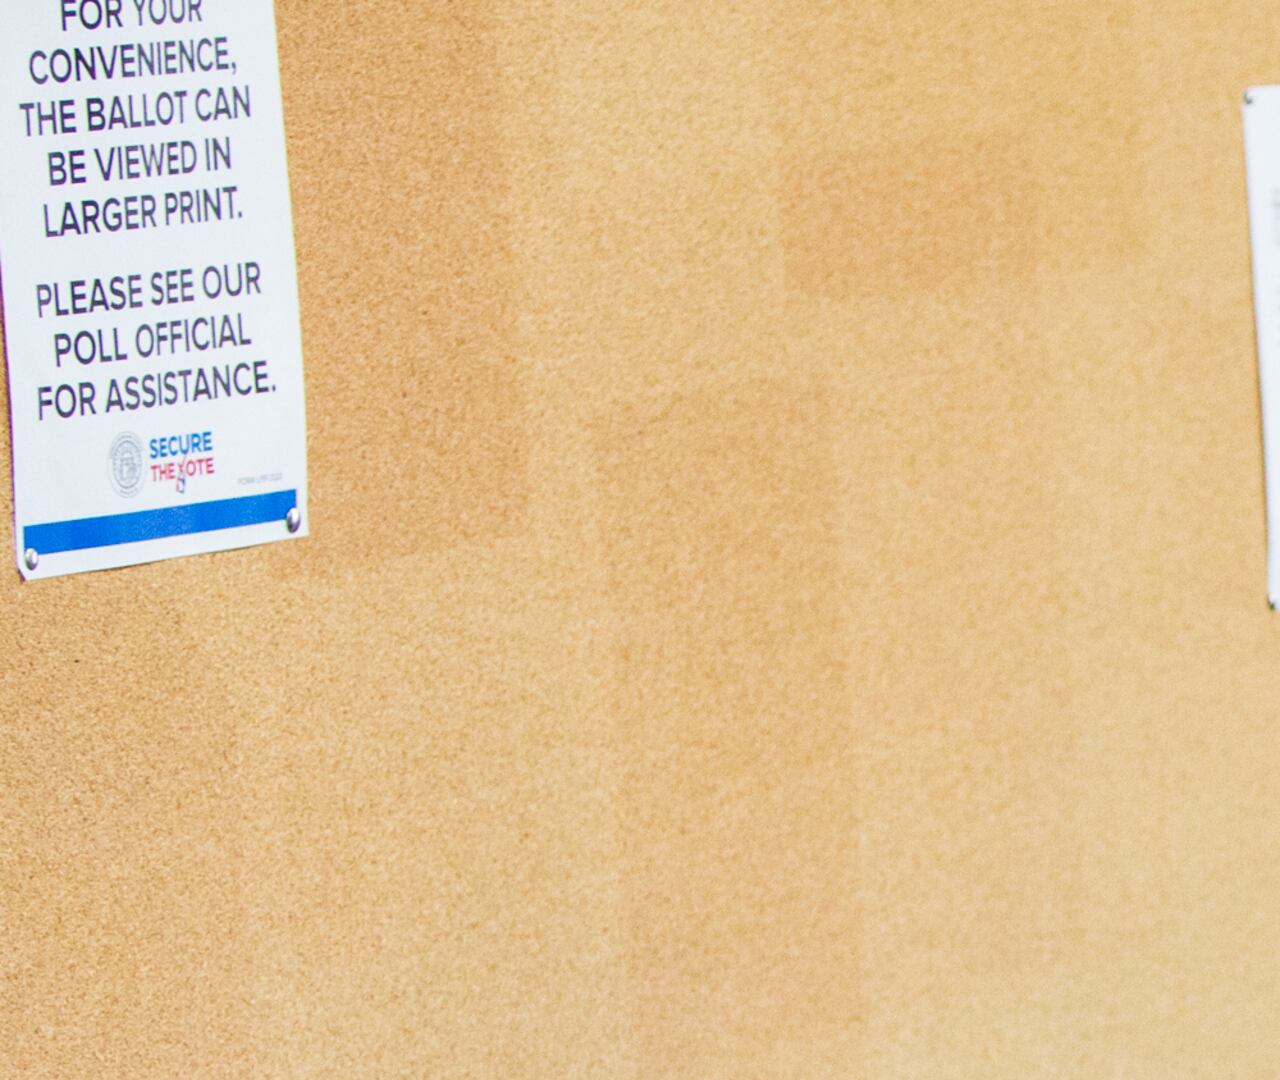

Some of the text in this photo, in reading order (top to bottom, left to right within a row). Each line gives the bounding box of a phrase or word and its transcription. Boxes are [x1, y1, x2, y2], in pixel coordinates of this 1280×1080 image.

[60, 0, 203, 31] FOR YOUR
[29, 36, 237, 85] CONVENIENCE,
[19, 85, 252, 137] THE BALLOT CAN
[48, 136, 232, 186] BE VIEWED IN
[43, 185, 243, 237] LARGER PRINT.
[36, 261, 262, 318] PLEASE SEE OUR
[54, 312, 252, 367] POLL OFFICIAL
[38, 360, 277, 421] FOR ASSISTANCE.
[149, 431, 213, 459] SECURE
[150, 462, 176, 482] THE
